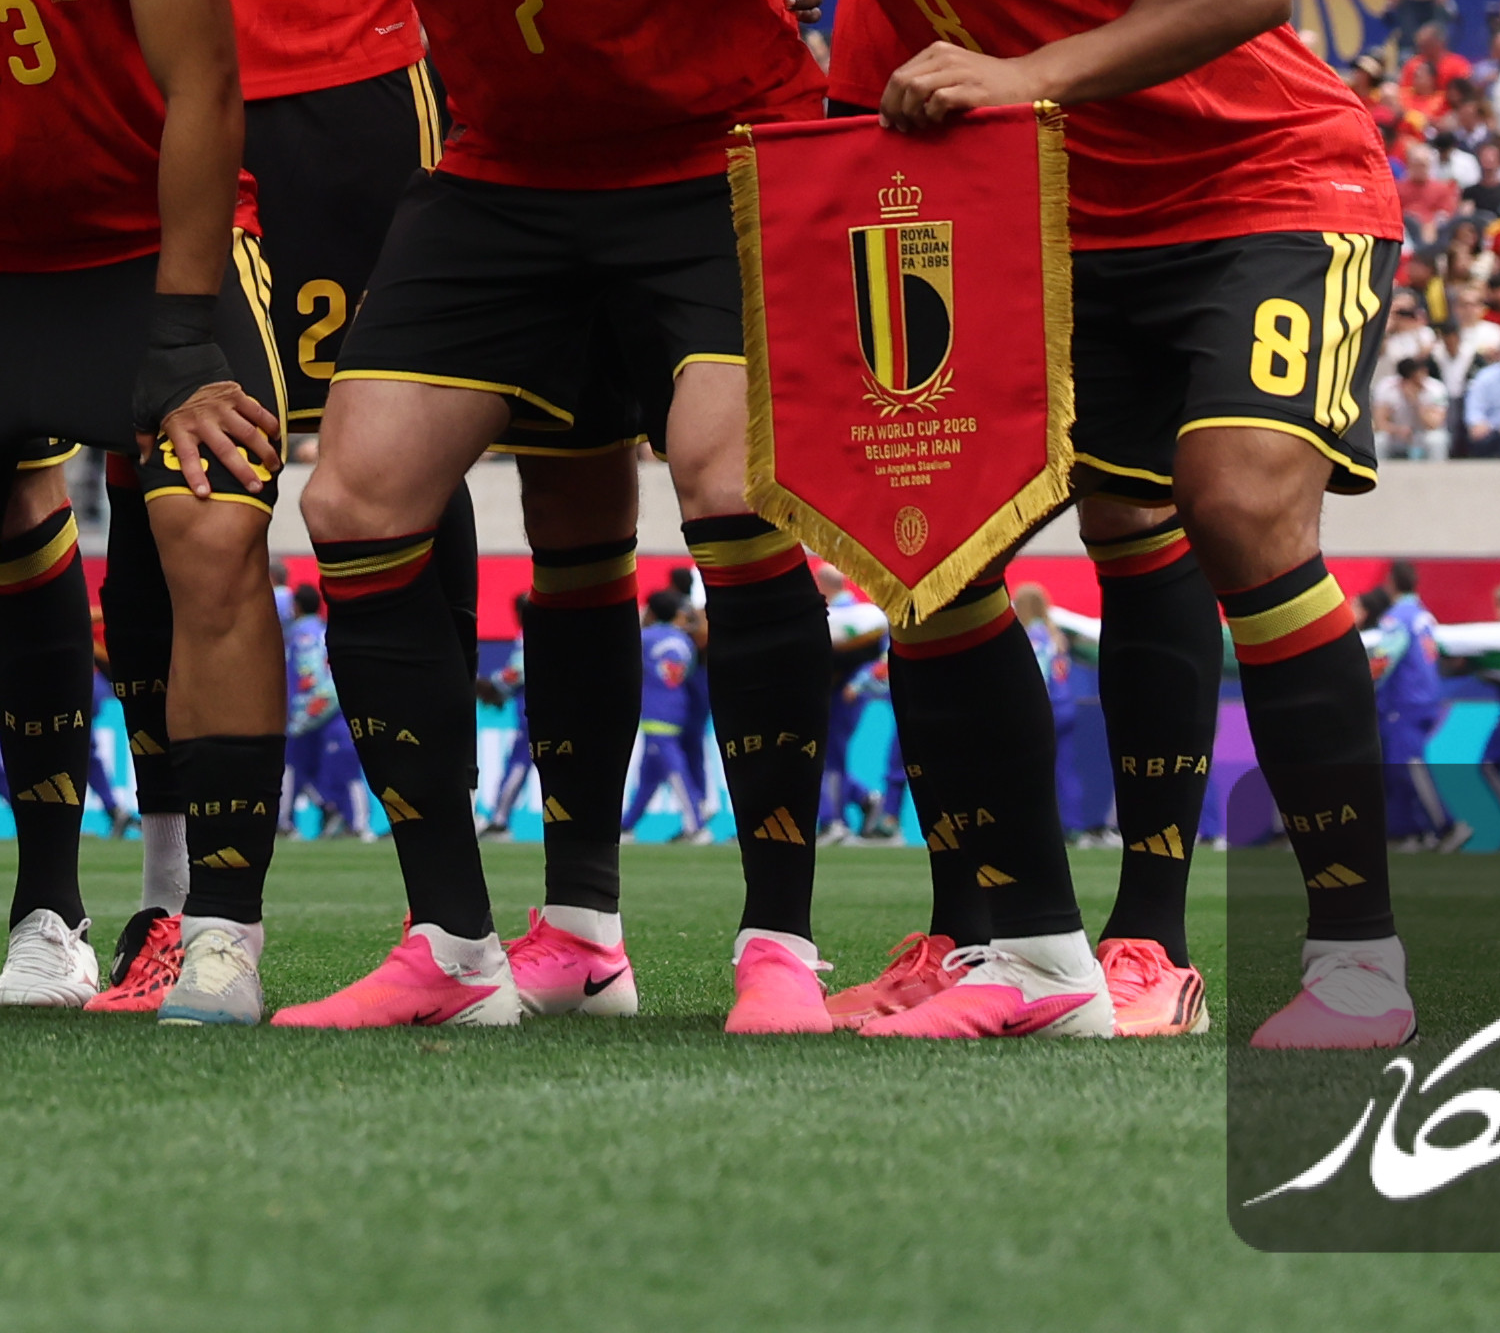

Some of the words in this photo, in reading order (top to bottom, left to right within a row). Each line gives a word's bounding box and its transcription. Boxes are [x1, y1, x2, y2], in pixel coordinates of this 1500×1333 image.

[901, 228, 937, 242] ROYAL
[901, 241, 949, 255] BELGIAN
[1250, 297, 1310, 397] 8
[851, 425, 875, 441] FIFA
[877, 422, 915, 440] WORLD
[917, 419, 940, 436] CUP
[943, 417, 977, 434] 2026
[931, 438, 961, 455] IRAN
[5, 709, 85, 737] RBFA
[726, 731, 818, 759] RBFA
[1121, 755, 1208, 778] RBFA
[189, 799, 267, 817] RBFA
